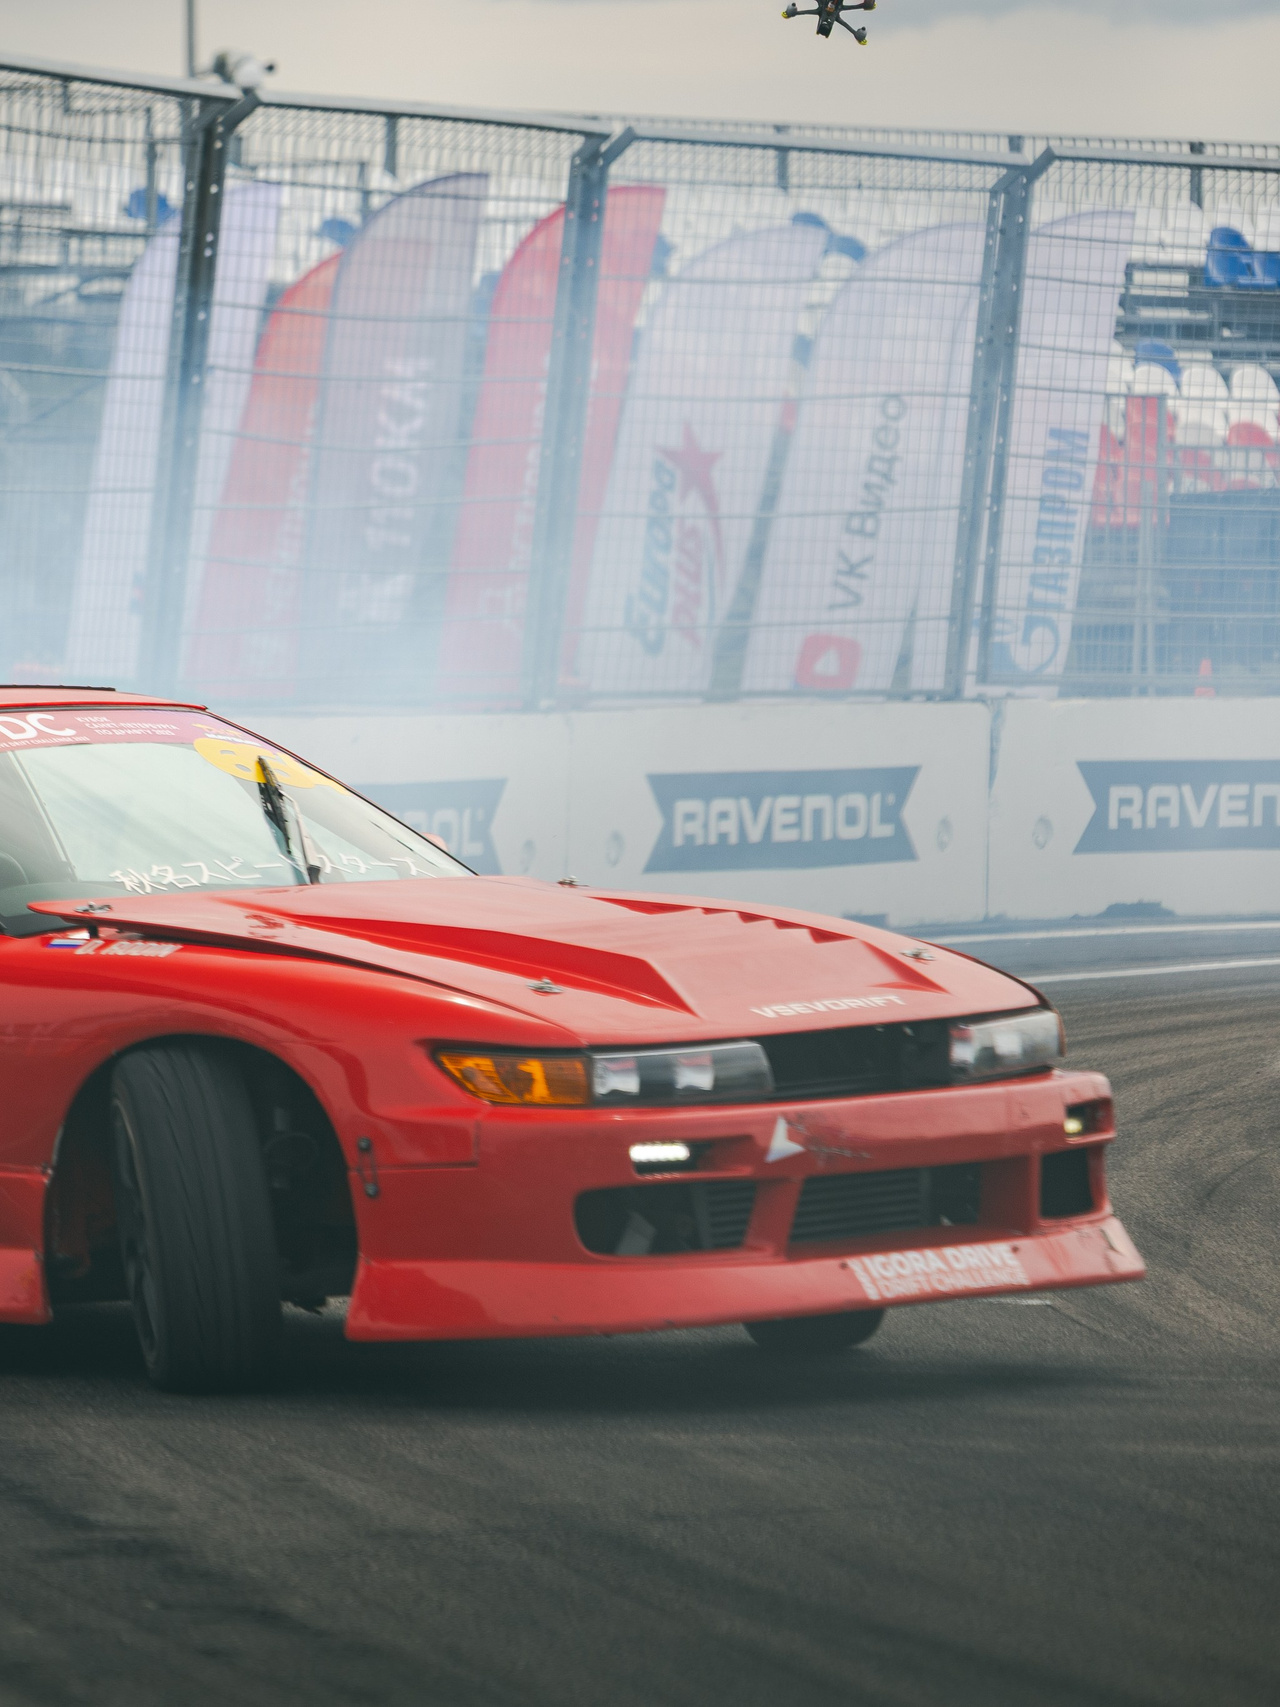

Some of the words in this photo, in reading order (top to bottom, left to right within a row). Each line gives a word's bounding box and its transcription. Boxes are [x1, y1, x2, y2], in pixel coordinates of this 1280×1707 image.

[845, 393, 908, 539] Видео
[826, 552, 873, 610] VK
[672, 792, 896, 848] RAVENOL
[749, 994, 907, 1019] VSEVDRIFT
[863, 1248, 950, 1279] IGORA
[941, 1242, 1020, 1271] DRIVE
